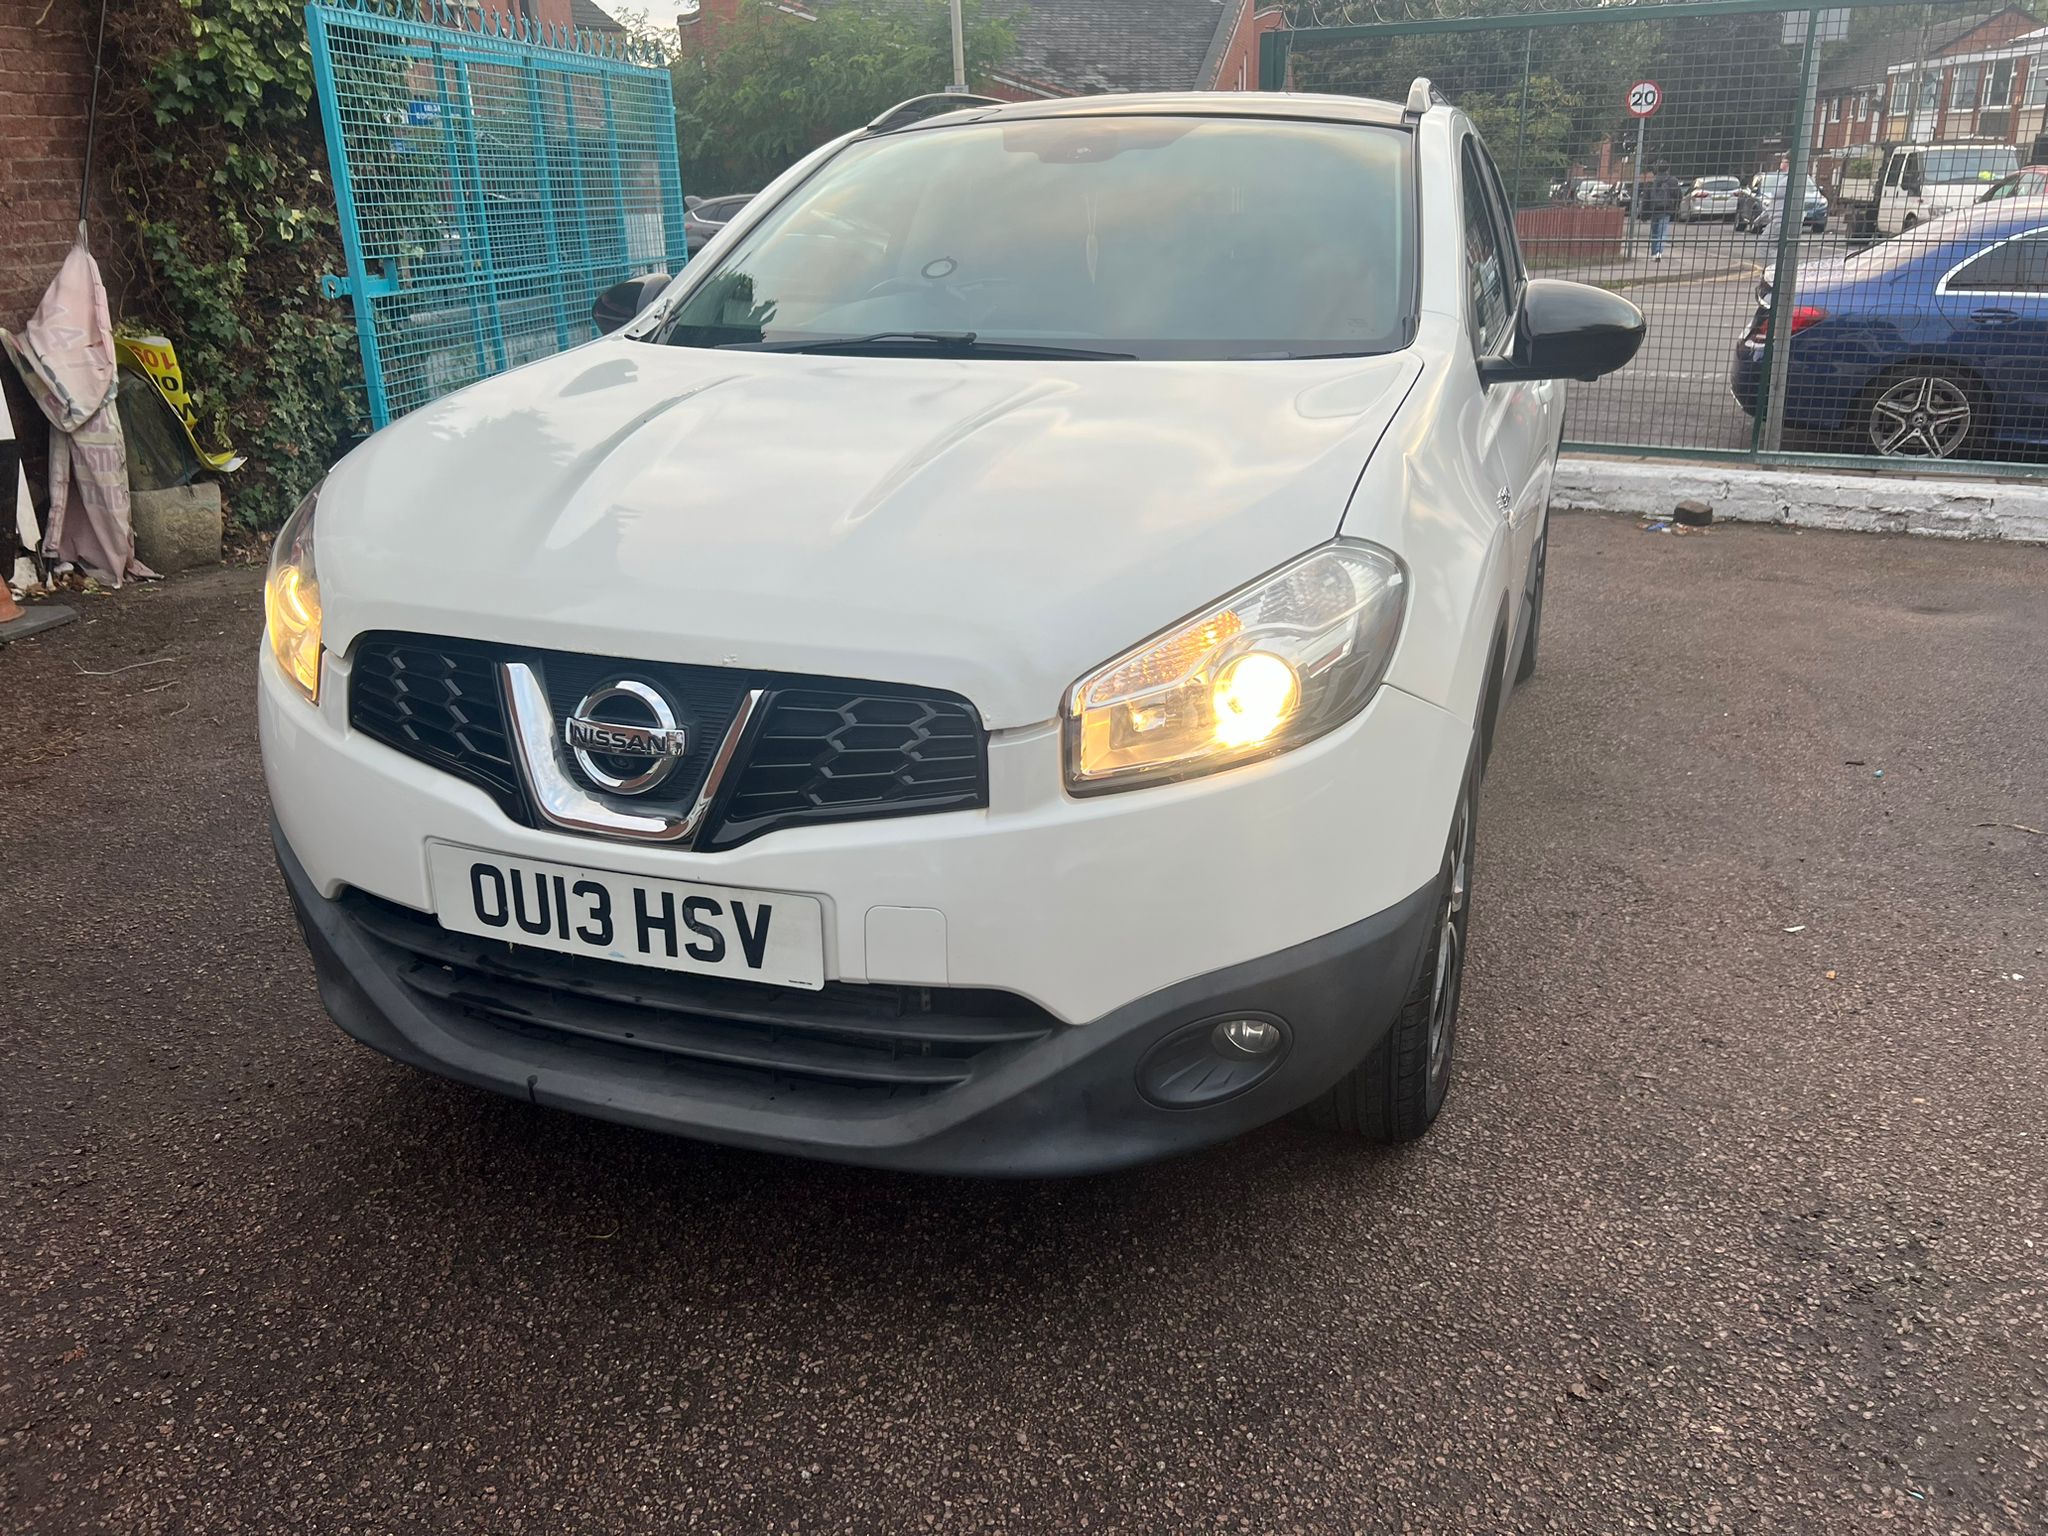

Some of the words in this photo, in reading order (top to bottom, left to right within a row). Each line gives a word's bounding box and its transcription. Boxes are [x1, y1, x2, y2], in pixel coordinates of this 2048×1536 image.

[1631, 90, 1656, 106] 20
[570, 720, 667, 755] NISSAN
[470, 862, 614, 947] OU13
[633, 887, 773, 970] HSV
